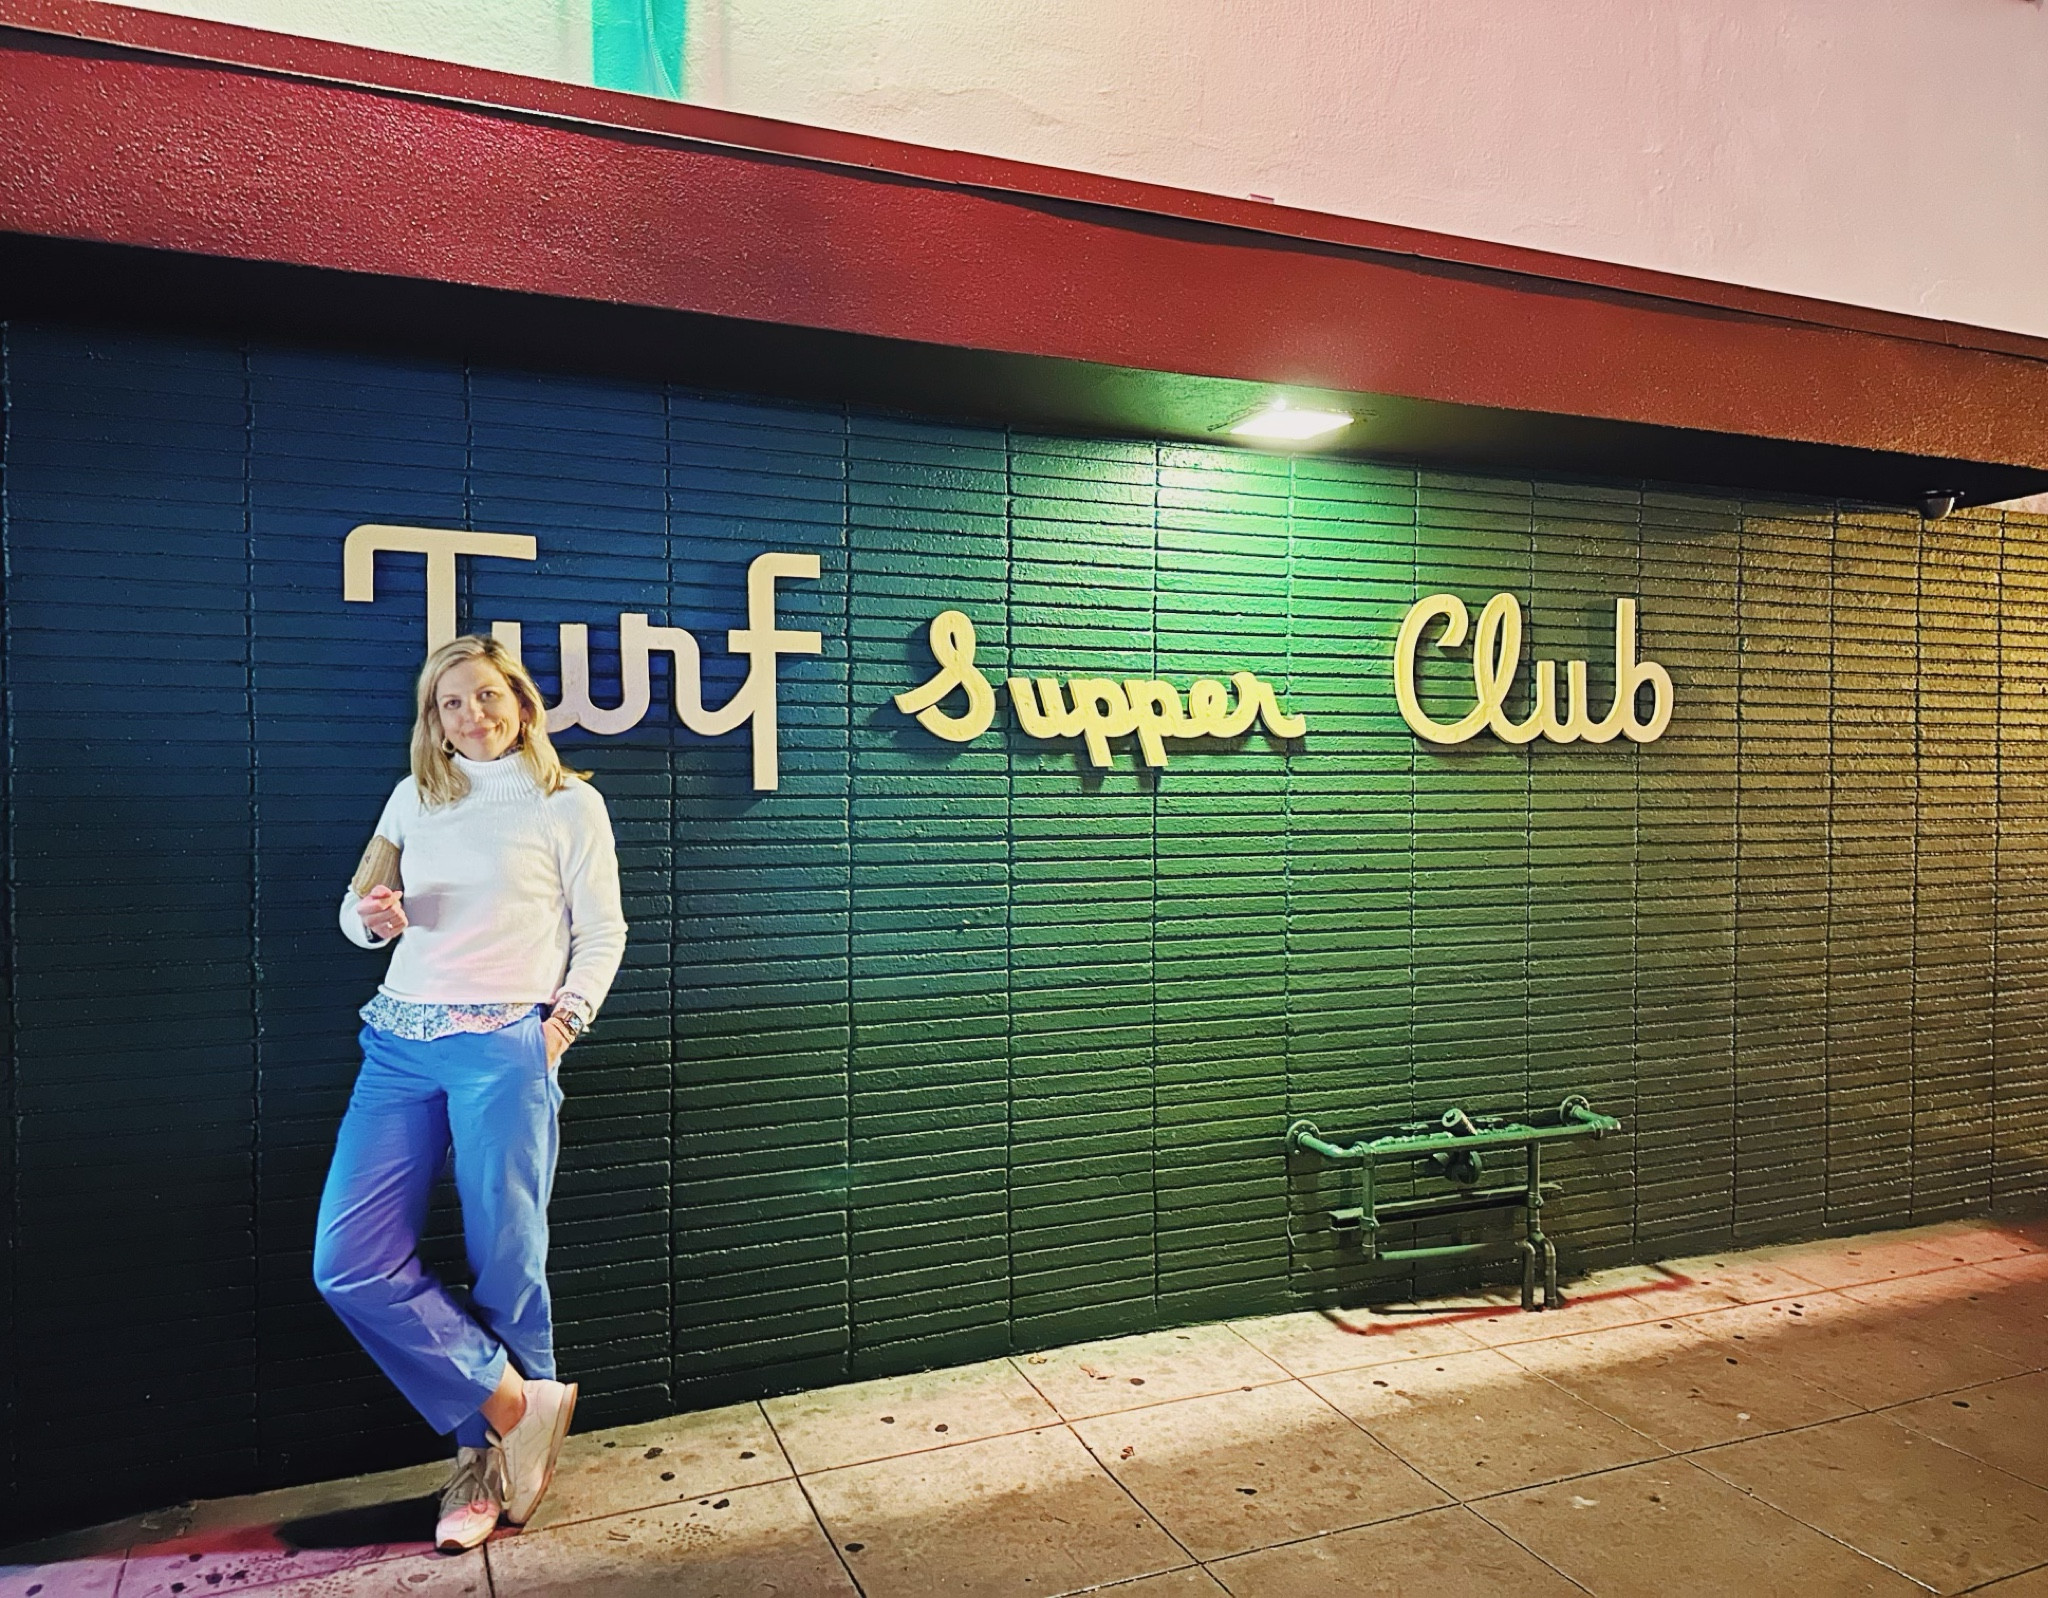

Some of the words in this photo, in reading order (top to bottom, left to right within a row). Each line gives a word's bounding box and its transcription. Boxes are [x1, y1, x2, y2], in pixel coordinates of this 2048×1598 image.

[344, 524, 821, 790] Turf
[894, 610, 1306, 767] Supper
[1394, 593, 1673, 744] Club
